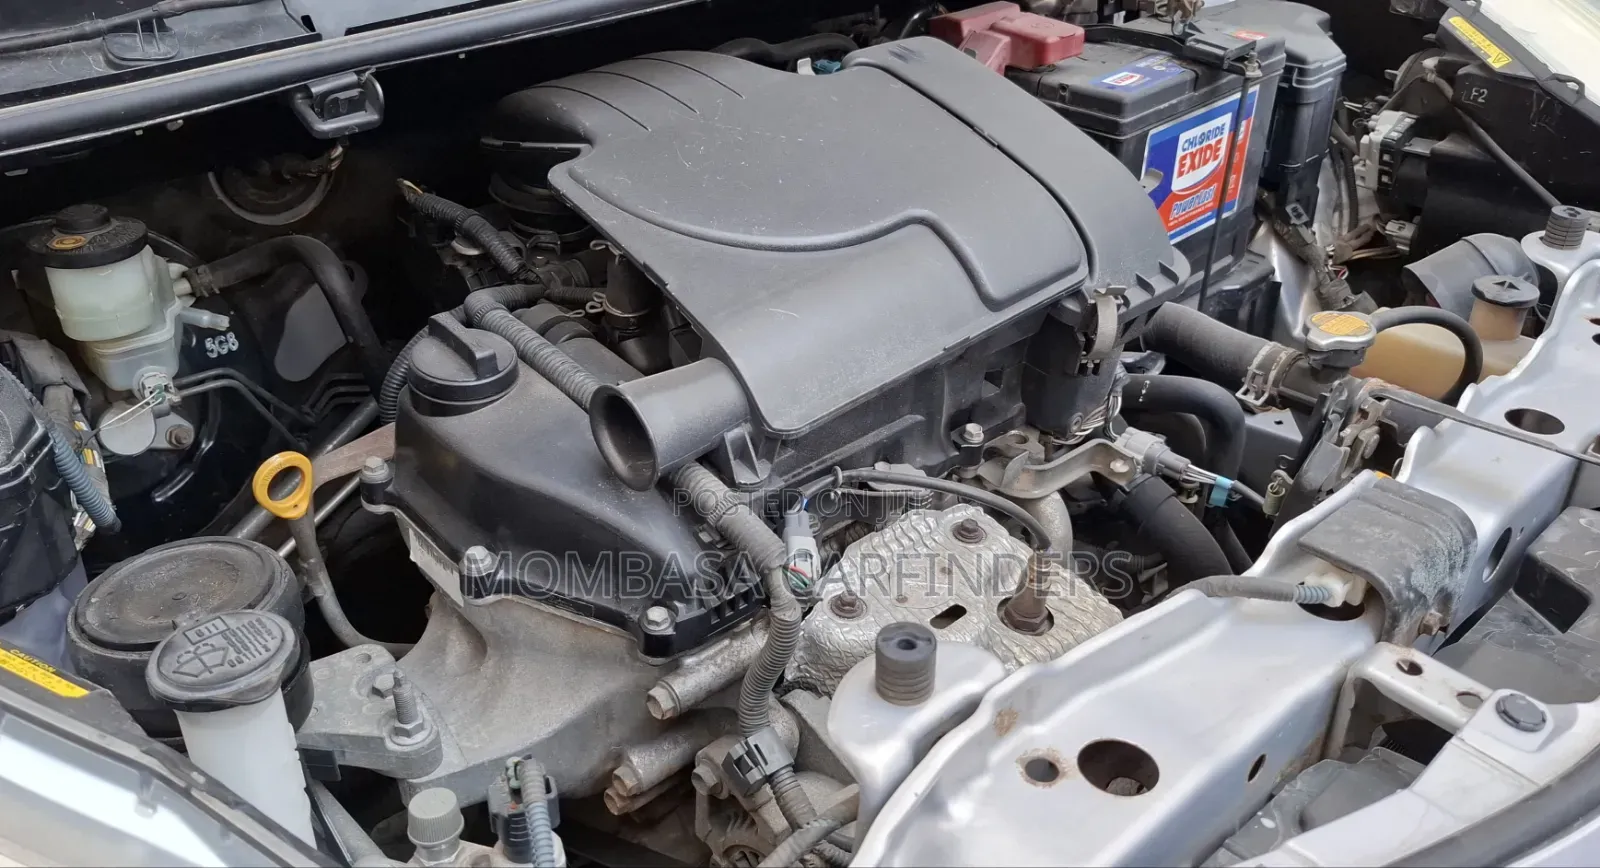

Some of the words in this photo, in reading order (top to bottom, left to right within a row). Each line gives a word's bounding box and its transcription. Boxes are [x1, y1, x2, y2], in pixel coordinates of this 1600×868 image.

[1470, 87, 1488, 103] F2
[1181, 122, 1226, 153] CHLORIDE
[1176, 137, 1224, 179] EXIDE
[10, 649, 57, 673] CAUTION
